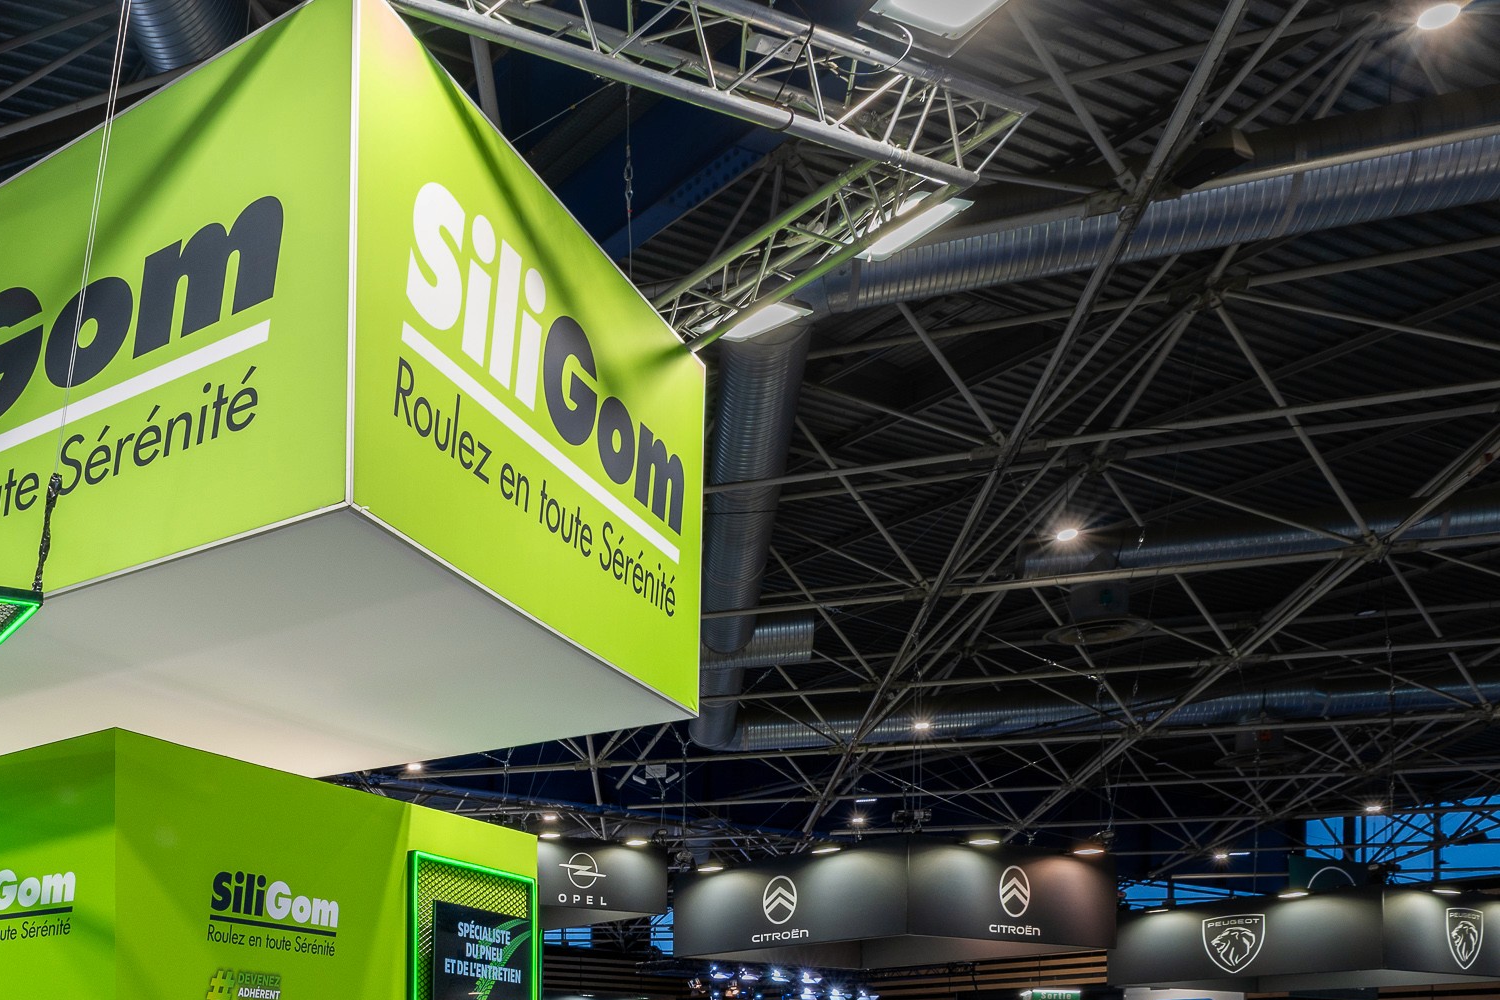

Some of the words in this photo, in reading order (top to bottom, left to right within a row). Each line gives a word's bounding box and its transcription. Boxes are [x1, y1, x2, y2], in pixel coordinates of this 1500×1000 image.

[406, 182, 684, 536] SiliGom
[58, 365, 258, 496] Sérénité
[393, 356, 492, 485] Roulez
[500, 462, 530, 514] en
[539, 480, 593, 558] toute
[599, 521, 677, 618] Sérénité
[211, 871, 339, 928] SiliGom
[558, 893, 608, 906] OPEL
[21, 917, 71, 939] Sérénité
[1207, 918, 1260, 928] PEUGEOT
[1449, 912, 1481, 921] PEUGEOT
[207, 924, 245, 945] Roulez
[249, 935, 262, 947] en
[266, 934, 291, 951] toute
[294, 936, 335, 957] Sérénité
[457, 920, 511, 945] SPÉCIALISTE
[465, 942, 478, 958] DU
[480, 946, 503, 962] PNEU
[238, 973, 280, 987] DEVENEZ
[444, 958, 456, 974] ET
[457, 960, 469, 976] DE
[470, 962, 522, 984] L'ENTRETIEN
[238, 986, 280, 1000] ADHÉRENT
